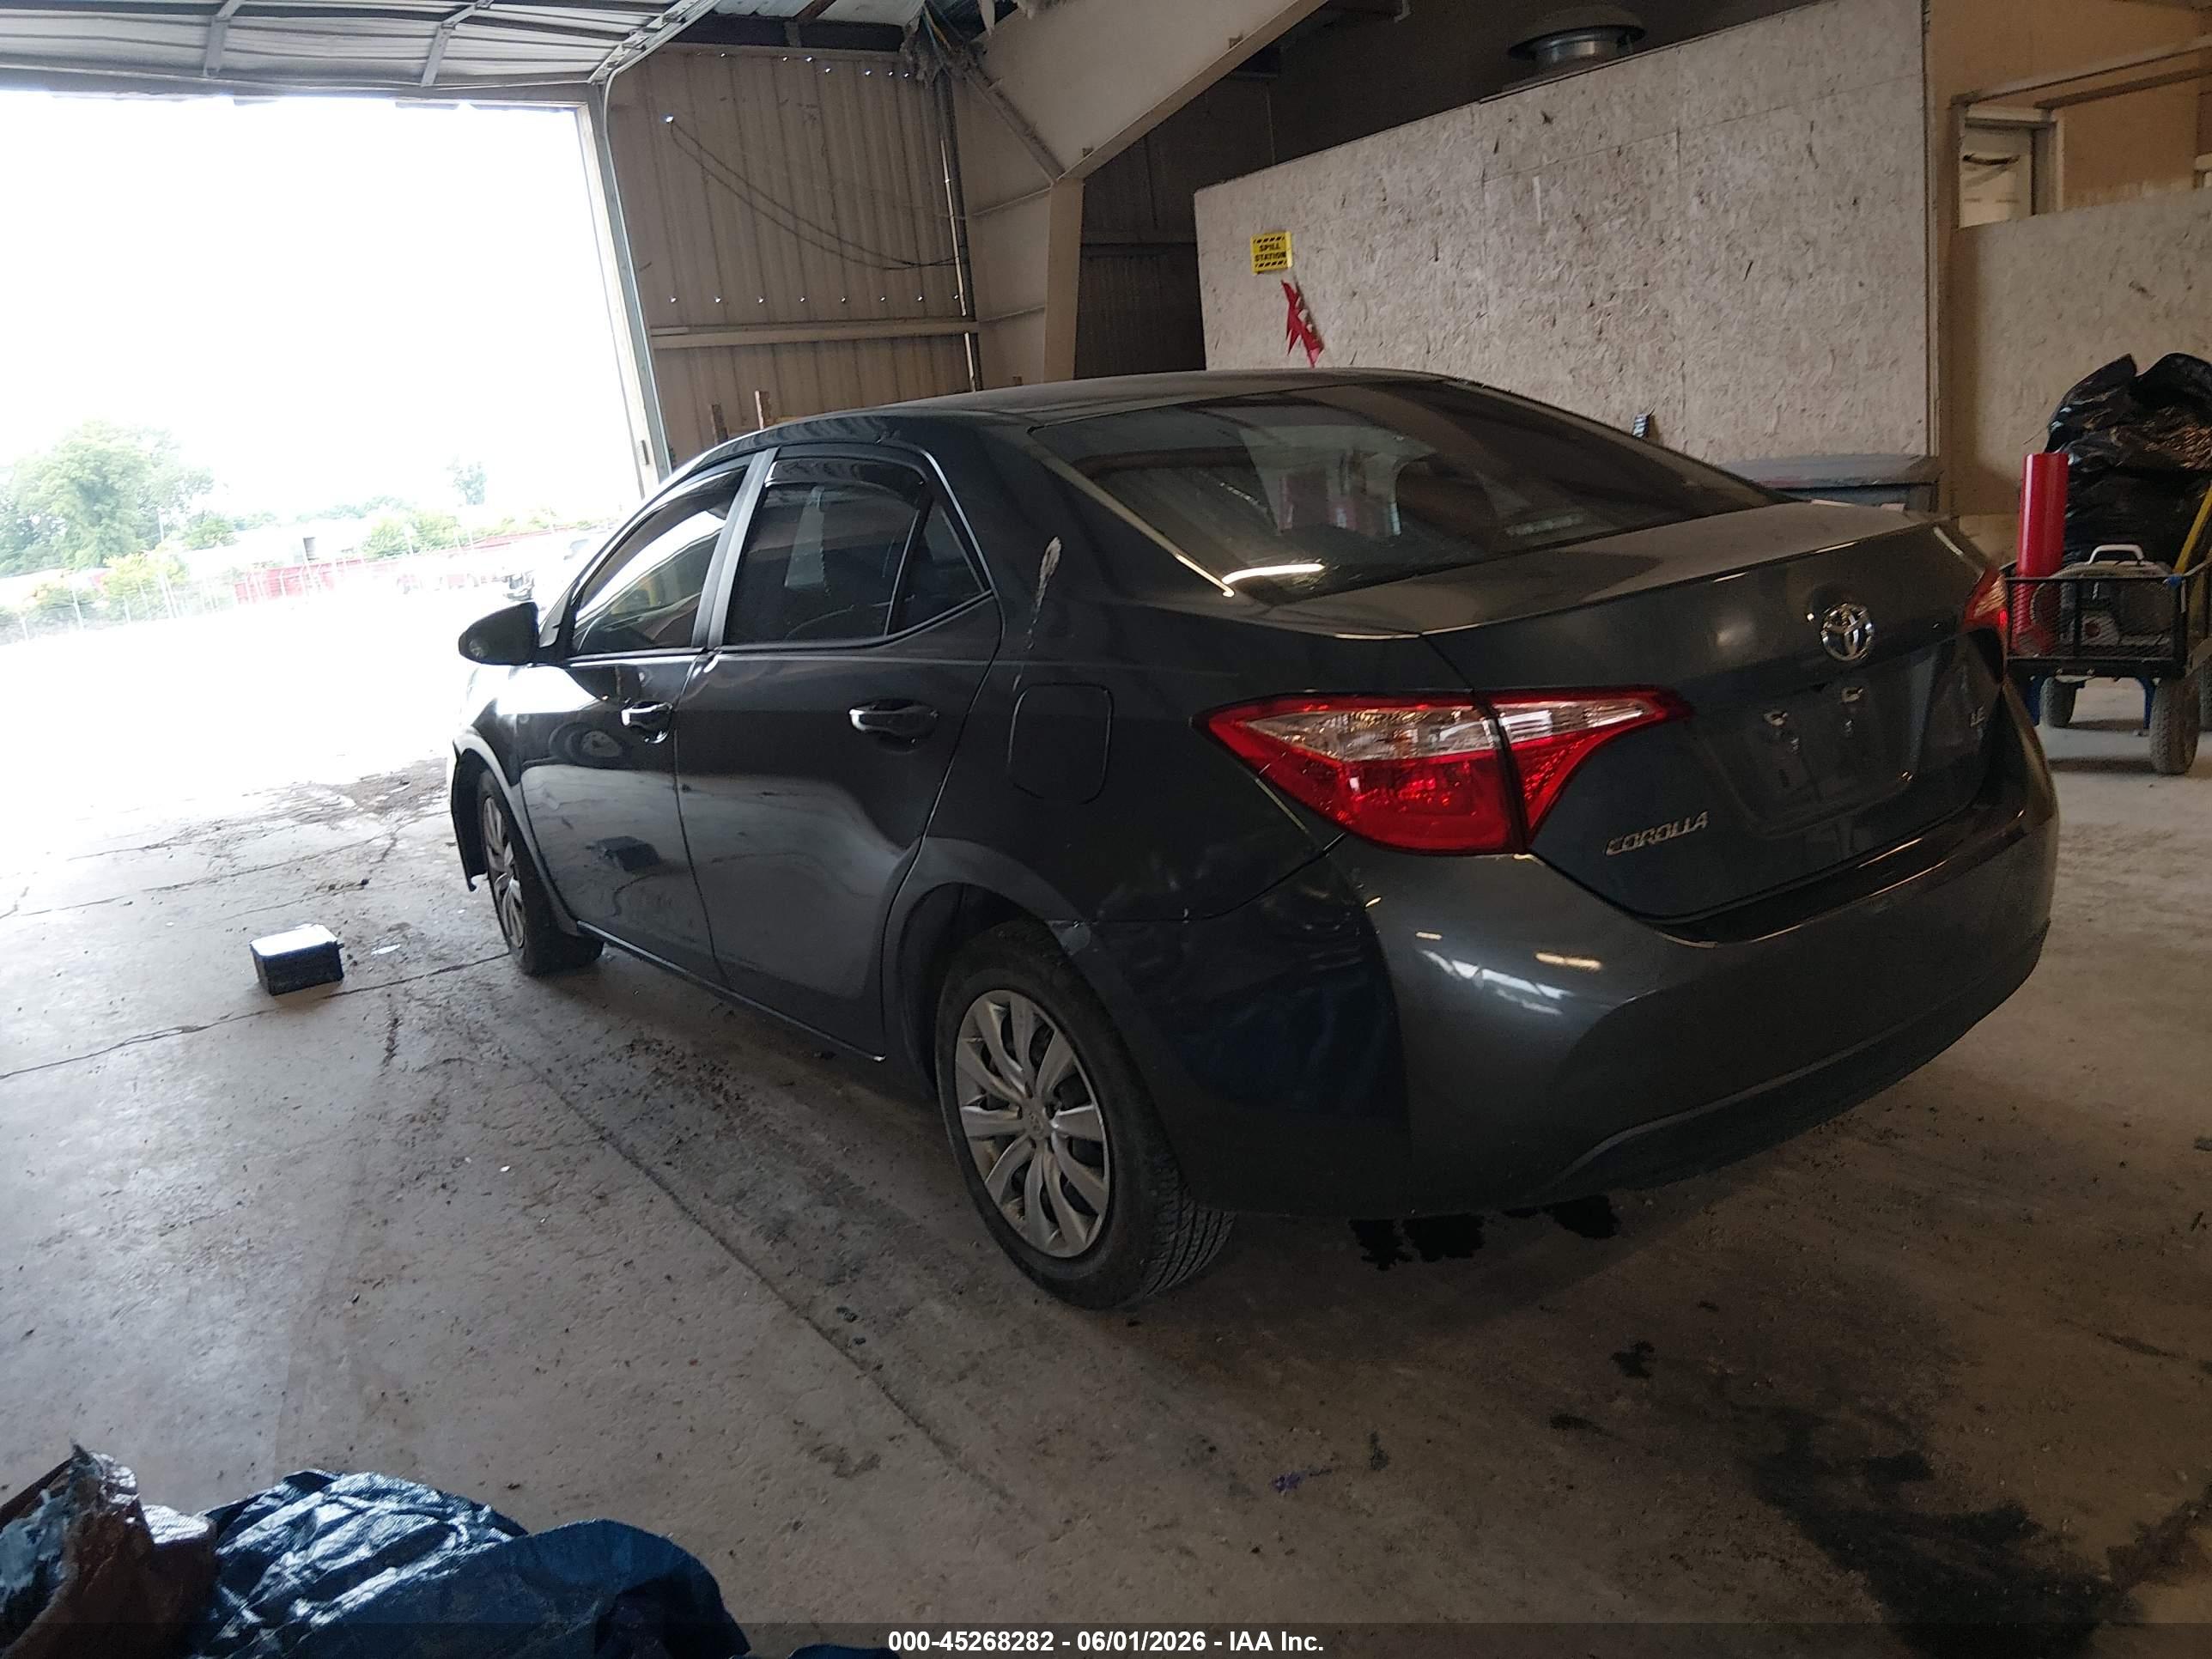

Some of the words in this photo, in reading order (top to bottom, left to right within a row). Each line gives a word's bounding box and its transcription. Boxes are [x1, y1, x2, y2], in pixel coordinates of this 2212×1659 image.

[1259, 242, 1280, 252] SPILL
[1255, 251, 1286, 262] STATION
[1605, 810, 1709, 856] COROLLA
